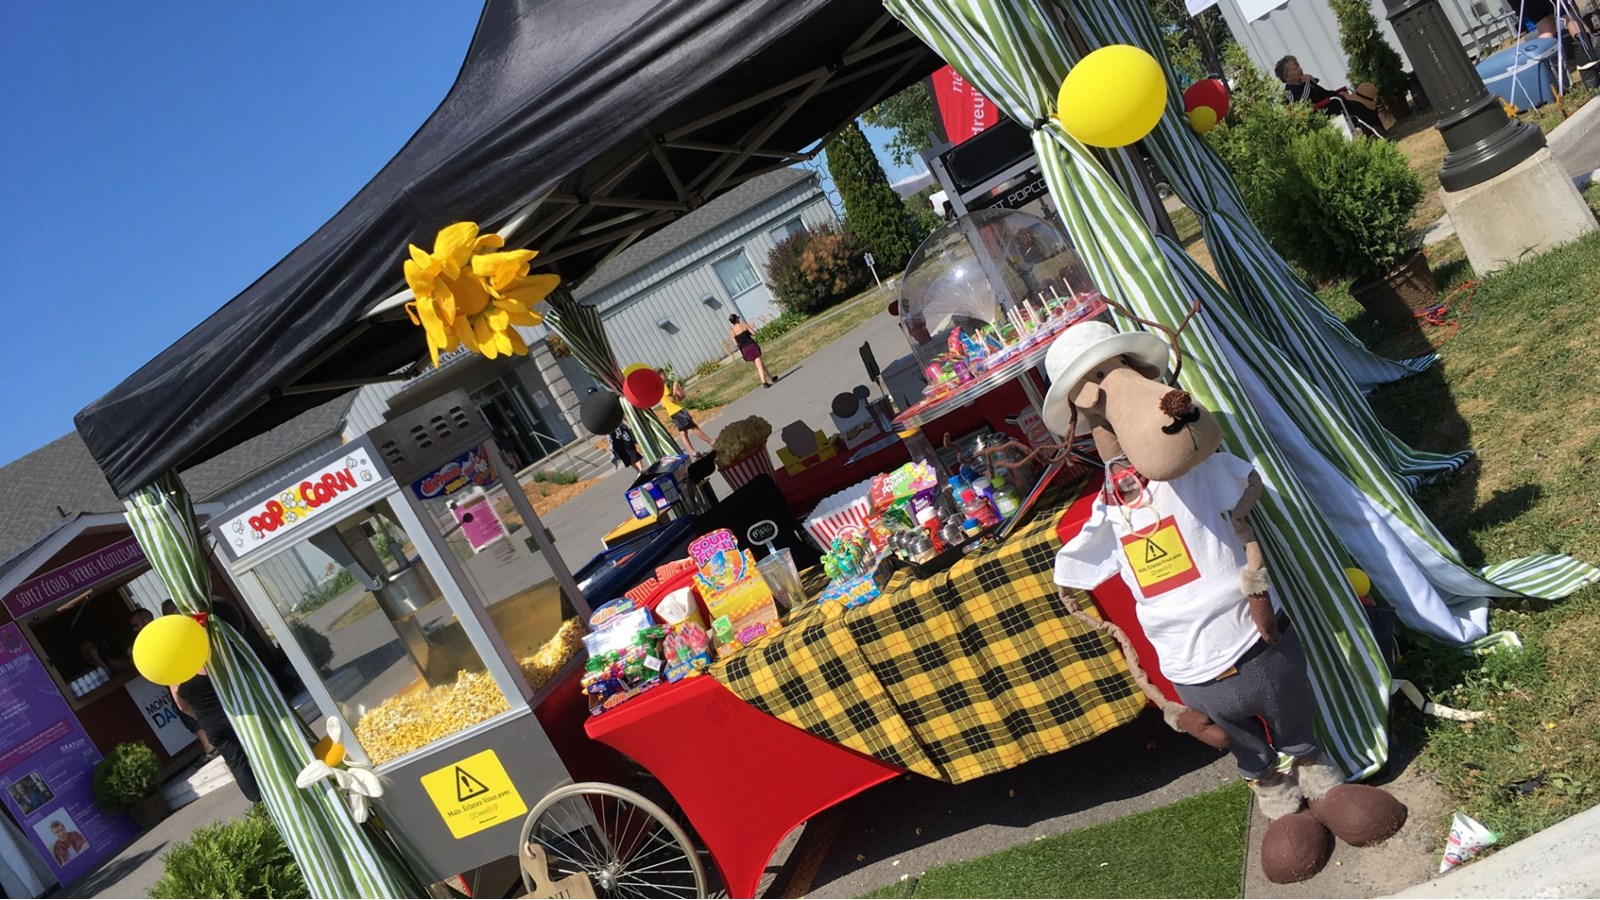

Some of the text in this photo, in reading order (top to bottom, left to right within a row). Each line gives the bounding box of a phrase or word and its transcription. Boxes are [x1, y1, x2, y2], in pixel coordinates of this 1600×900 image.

[1007, 178, 1047, 206] POPCO
[248, 468, 358, 539] POP CORN
[691, 532, 730, 554] SOUR
[697, 539, 734, 568] FLUSH
[15, 586, 43, 609] SOYEZ
[69, 560, 101, 583] VERRES
